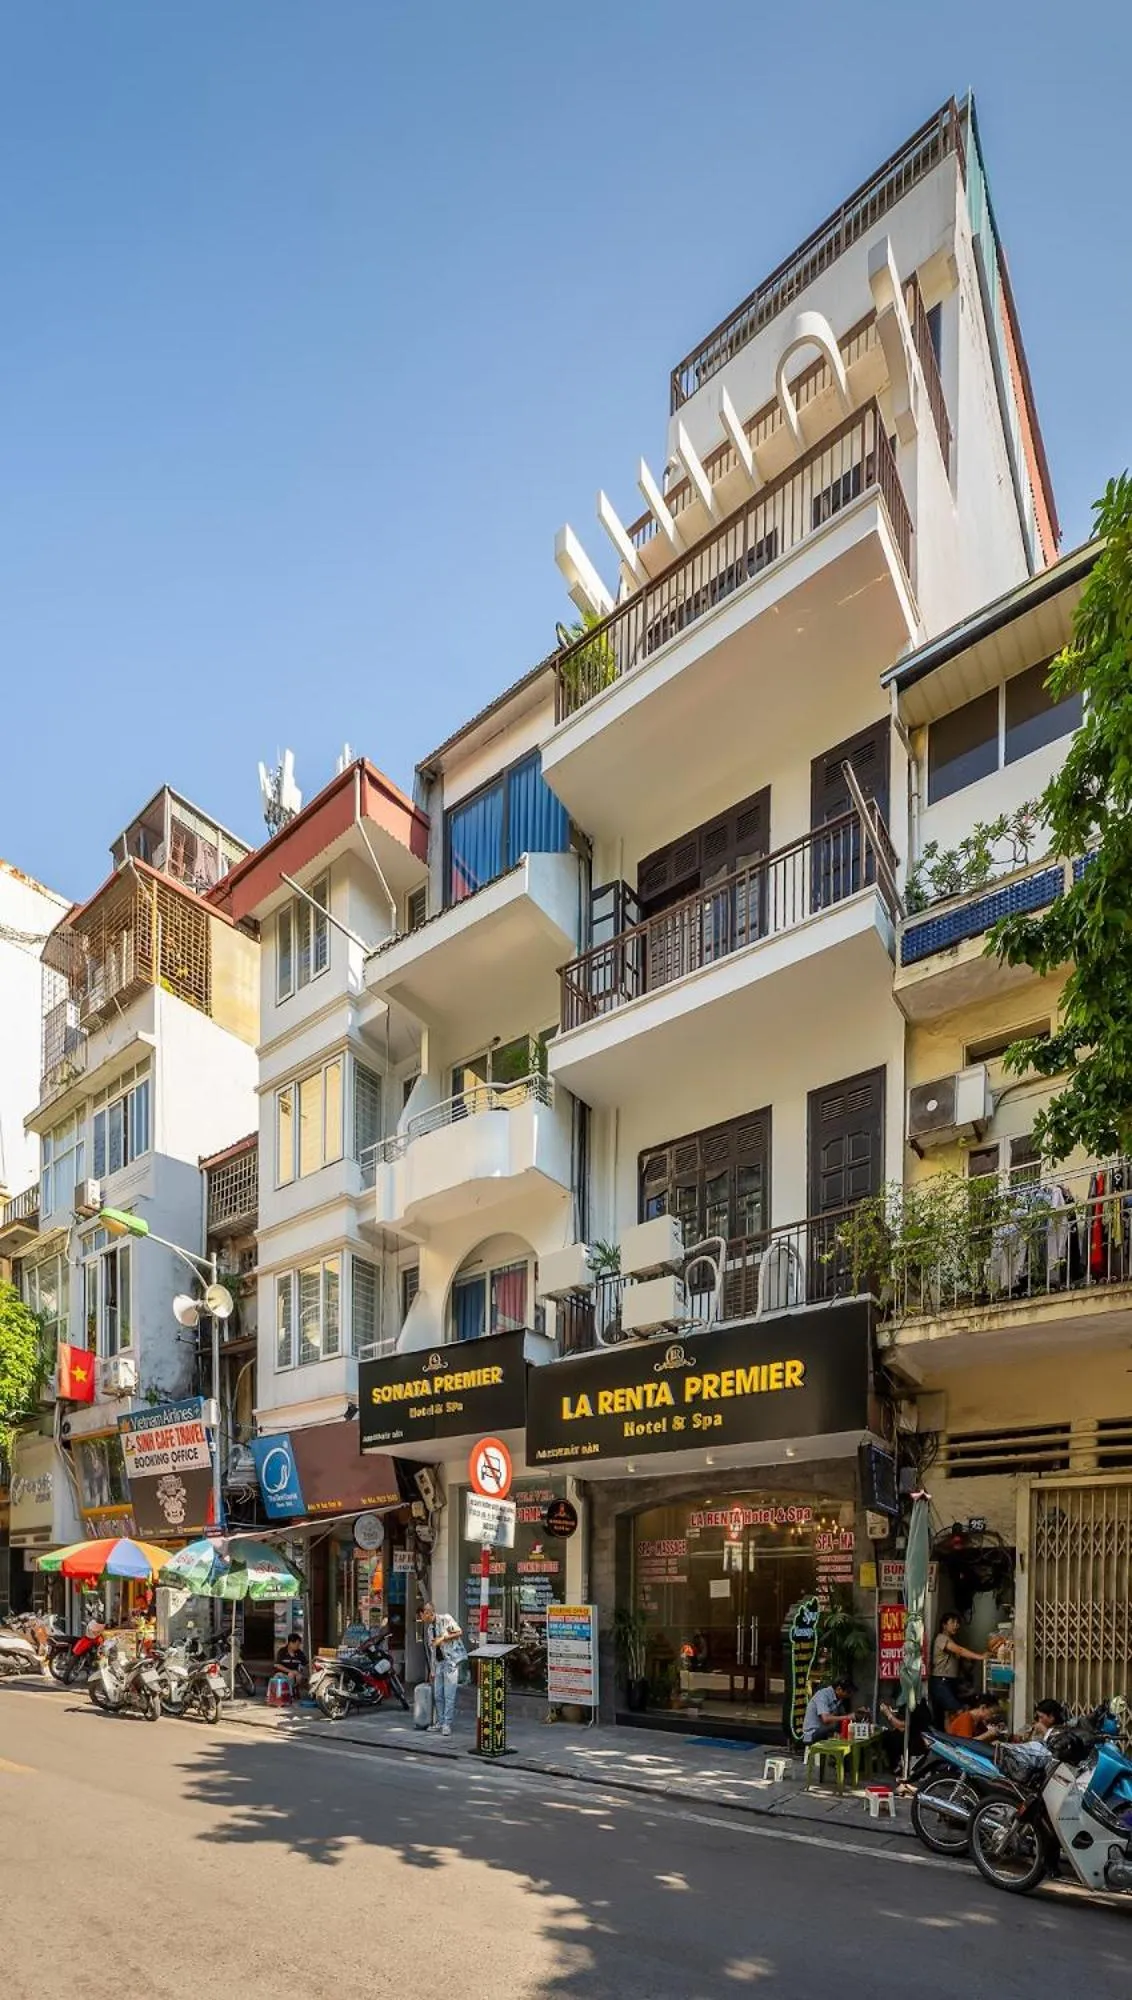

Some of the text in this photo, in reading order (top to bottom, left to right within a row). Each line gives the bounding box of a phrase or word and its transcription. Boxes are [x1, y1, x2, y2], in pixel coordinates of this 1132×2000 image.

[371, 1366, 503, 1405] SONATA PREMIER
[562, 1360, 805, 1420] LA RENTA PREMIER
[131, 1406, 194, 1431] Vietnam Airlines
[409, 1404, 434, 1418] Hotel
[155, 1428, 174, 1450] CAFE
[175, 1423, 205, 1447] TRAVEL
[624, 1412, 723, 1437] Hotel & Spa
[134, 1448, 199, 1468] BOOKING OFFICE
[690, 1505, 812, 1526] LA RENTA Hotel & Spa
[816, 1533, 834, 1551] SPA
